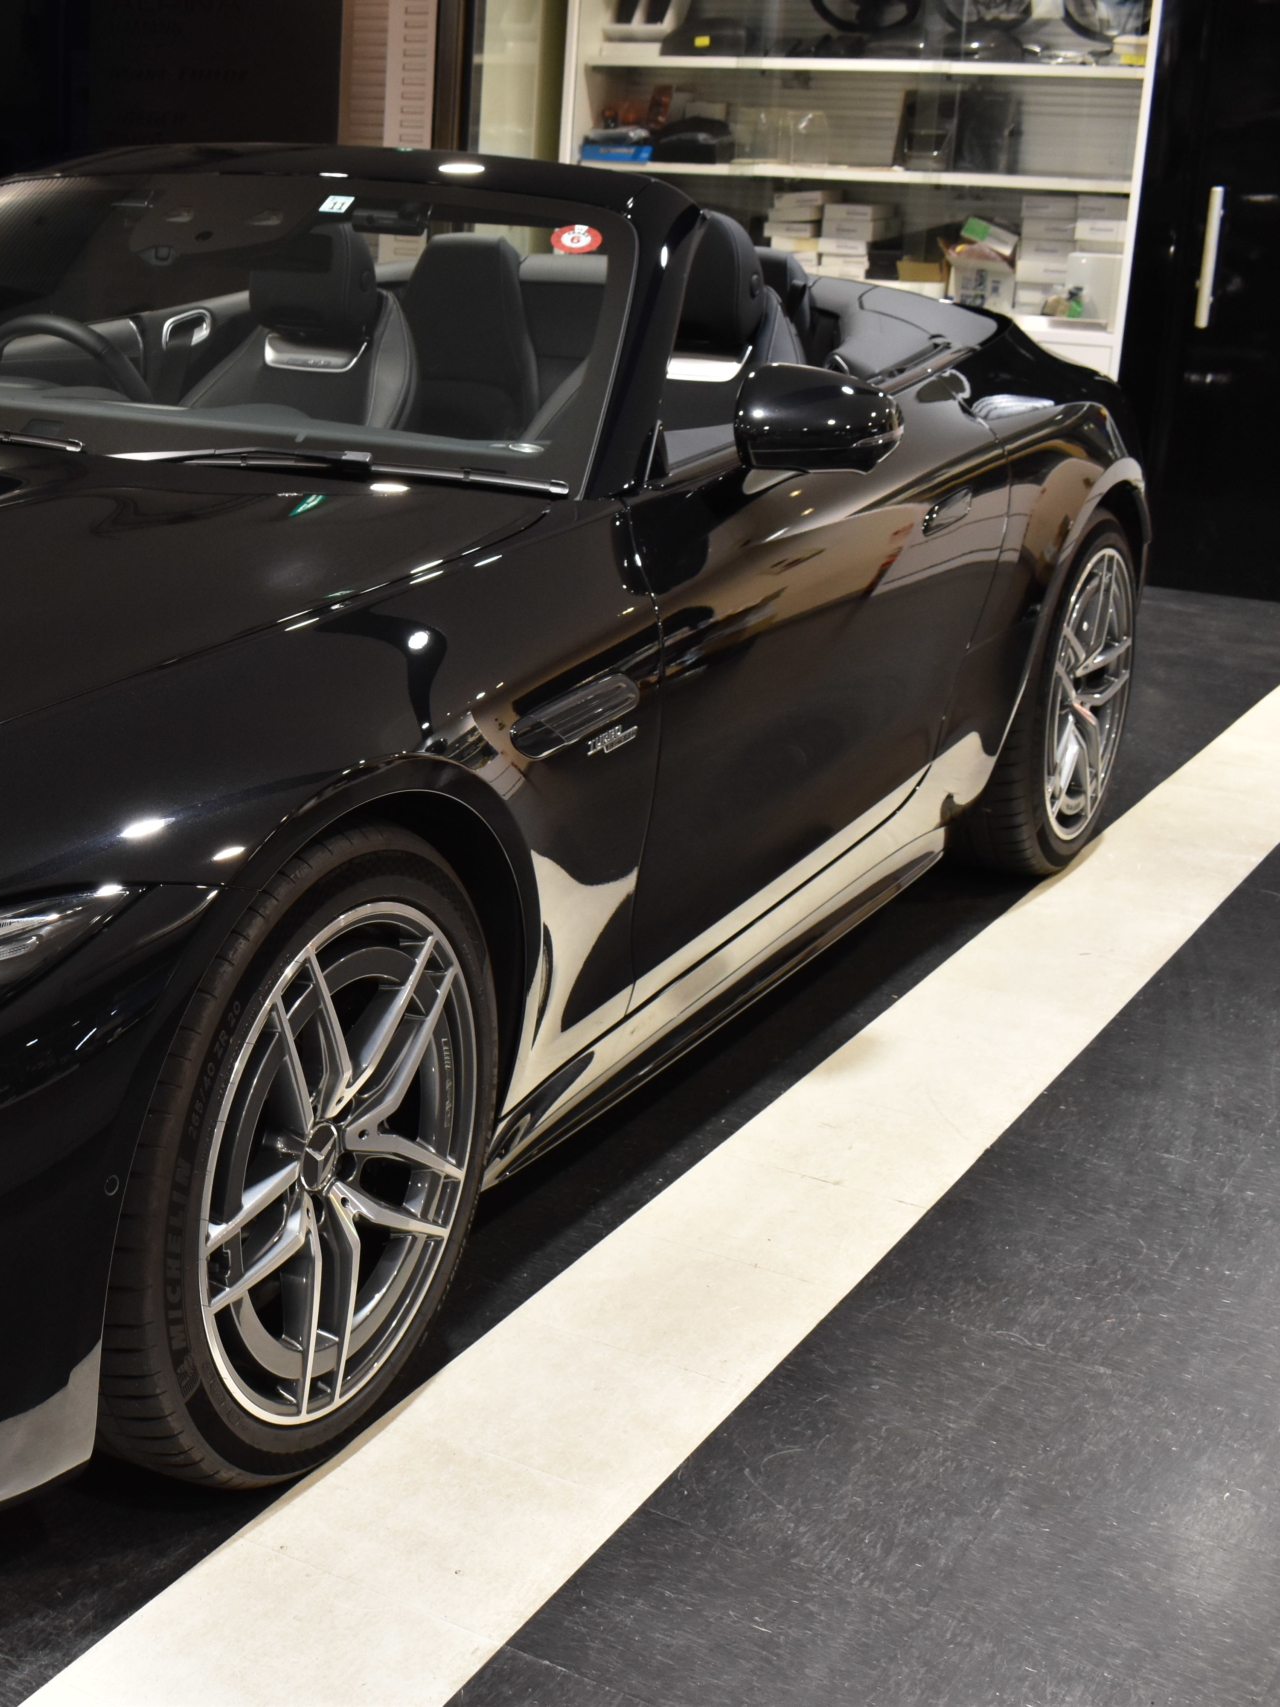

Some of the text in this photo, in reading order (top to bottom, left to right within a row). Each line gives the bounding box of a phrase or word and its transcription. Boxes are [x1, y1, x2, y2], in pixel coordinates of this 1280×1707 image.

[330, 201, 346, 210] 11
[570, 235, 580, 244] 6
[188, 1060, 215, 1140] 265/40
[228, 1001, 242, 1025] 20
[165, 1156, 192, 1350] MICHELIN
